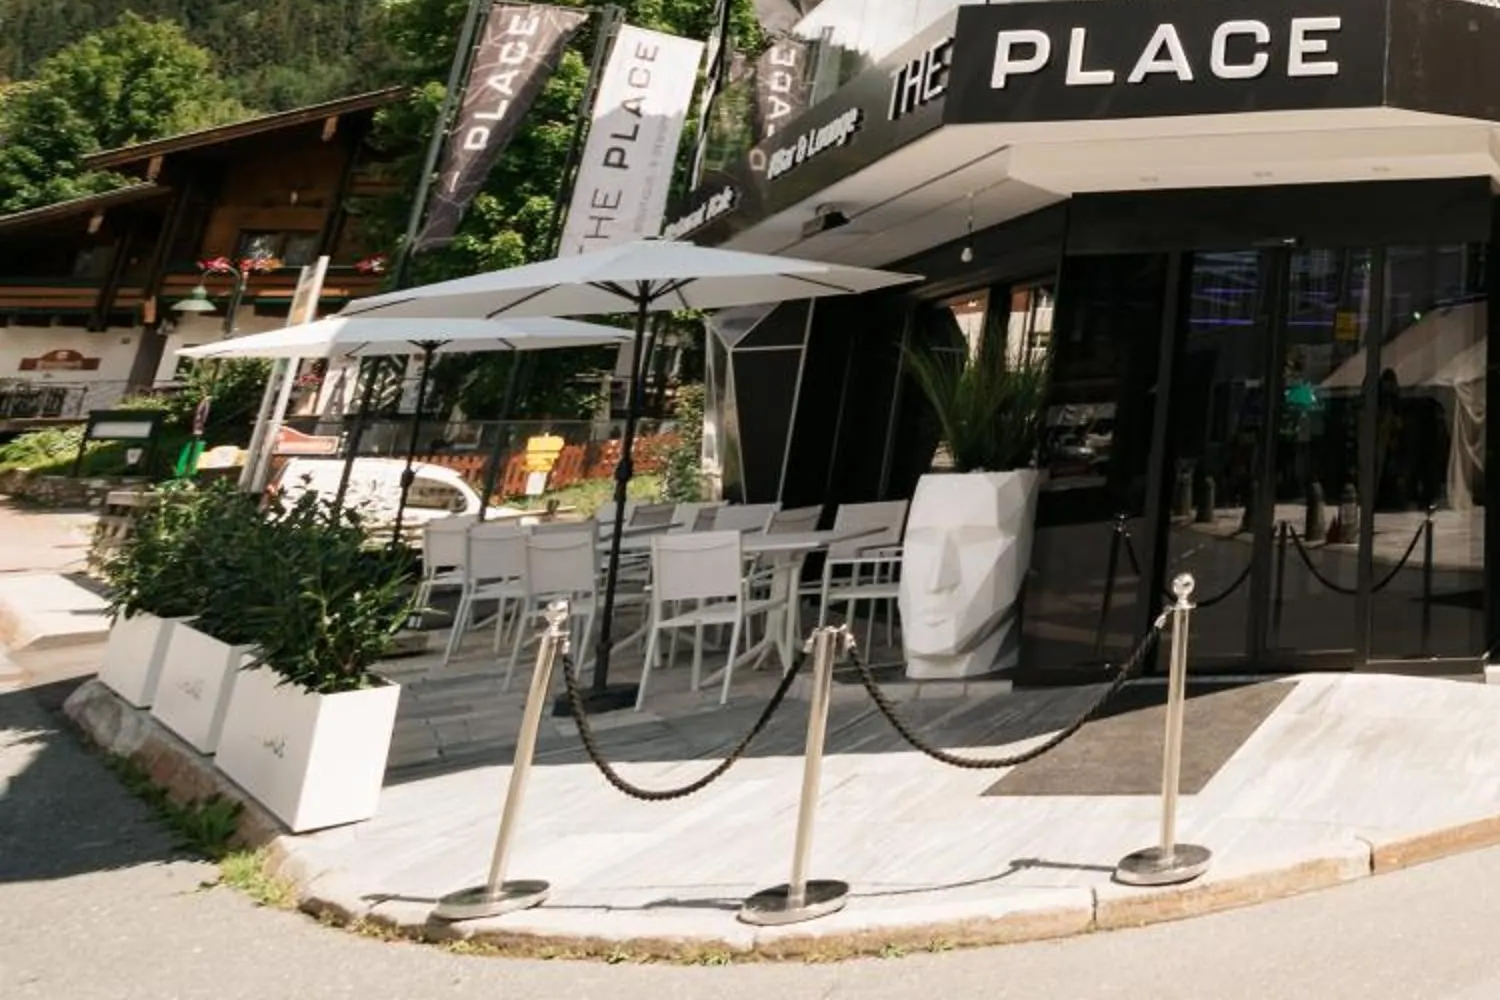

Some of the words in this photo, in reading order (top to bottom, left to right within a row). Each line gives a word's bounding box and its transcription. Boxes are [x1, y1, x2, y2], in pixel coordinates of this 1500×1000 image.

[463, 13, 541, 151] PLACE
[887, 36, 950, 121] THE
[989, 16, 1342, 89] PLACE
[578, 188, 622, 255] HE
[602, 42, 660, 170] PLACE
